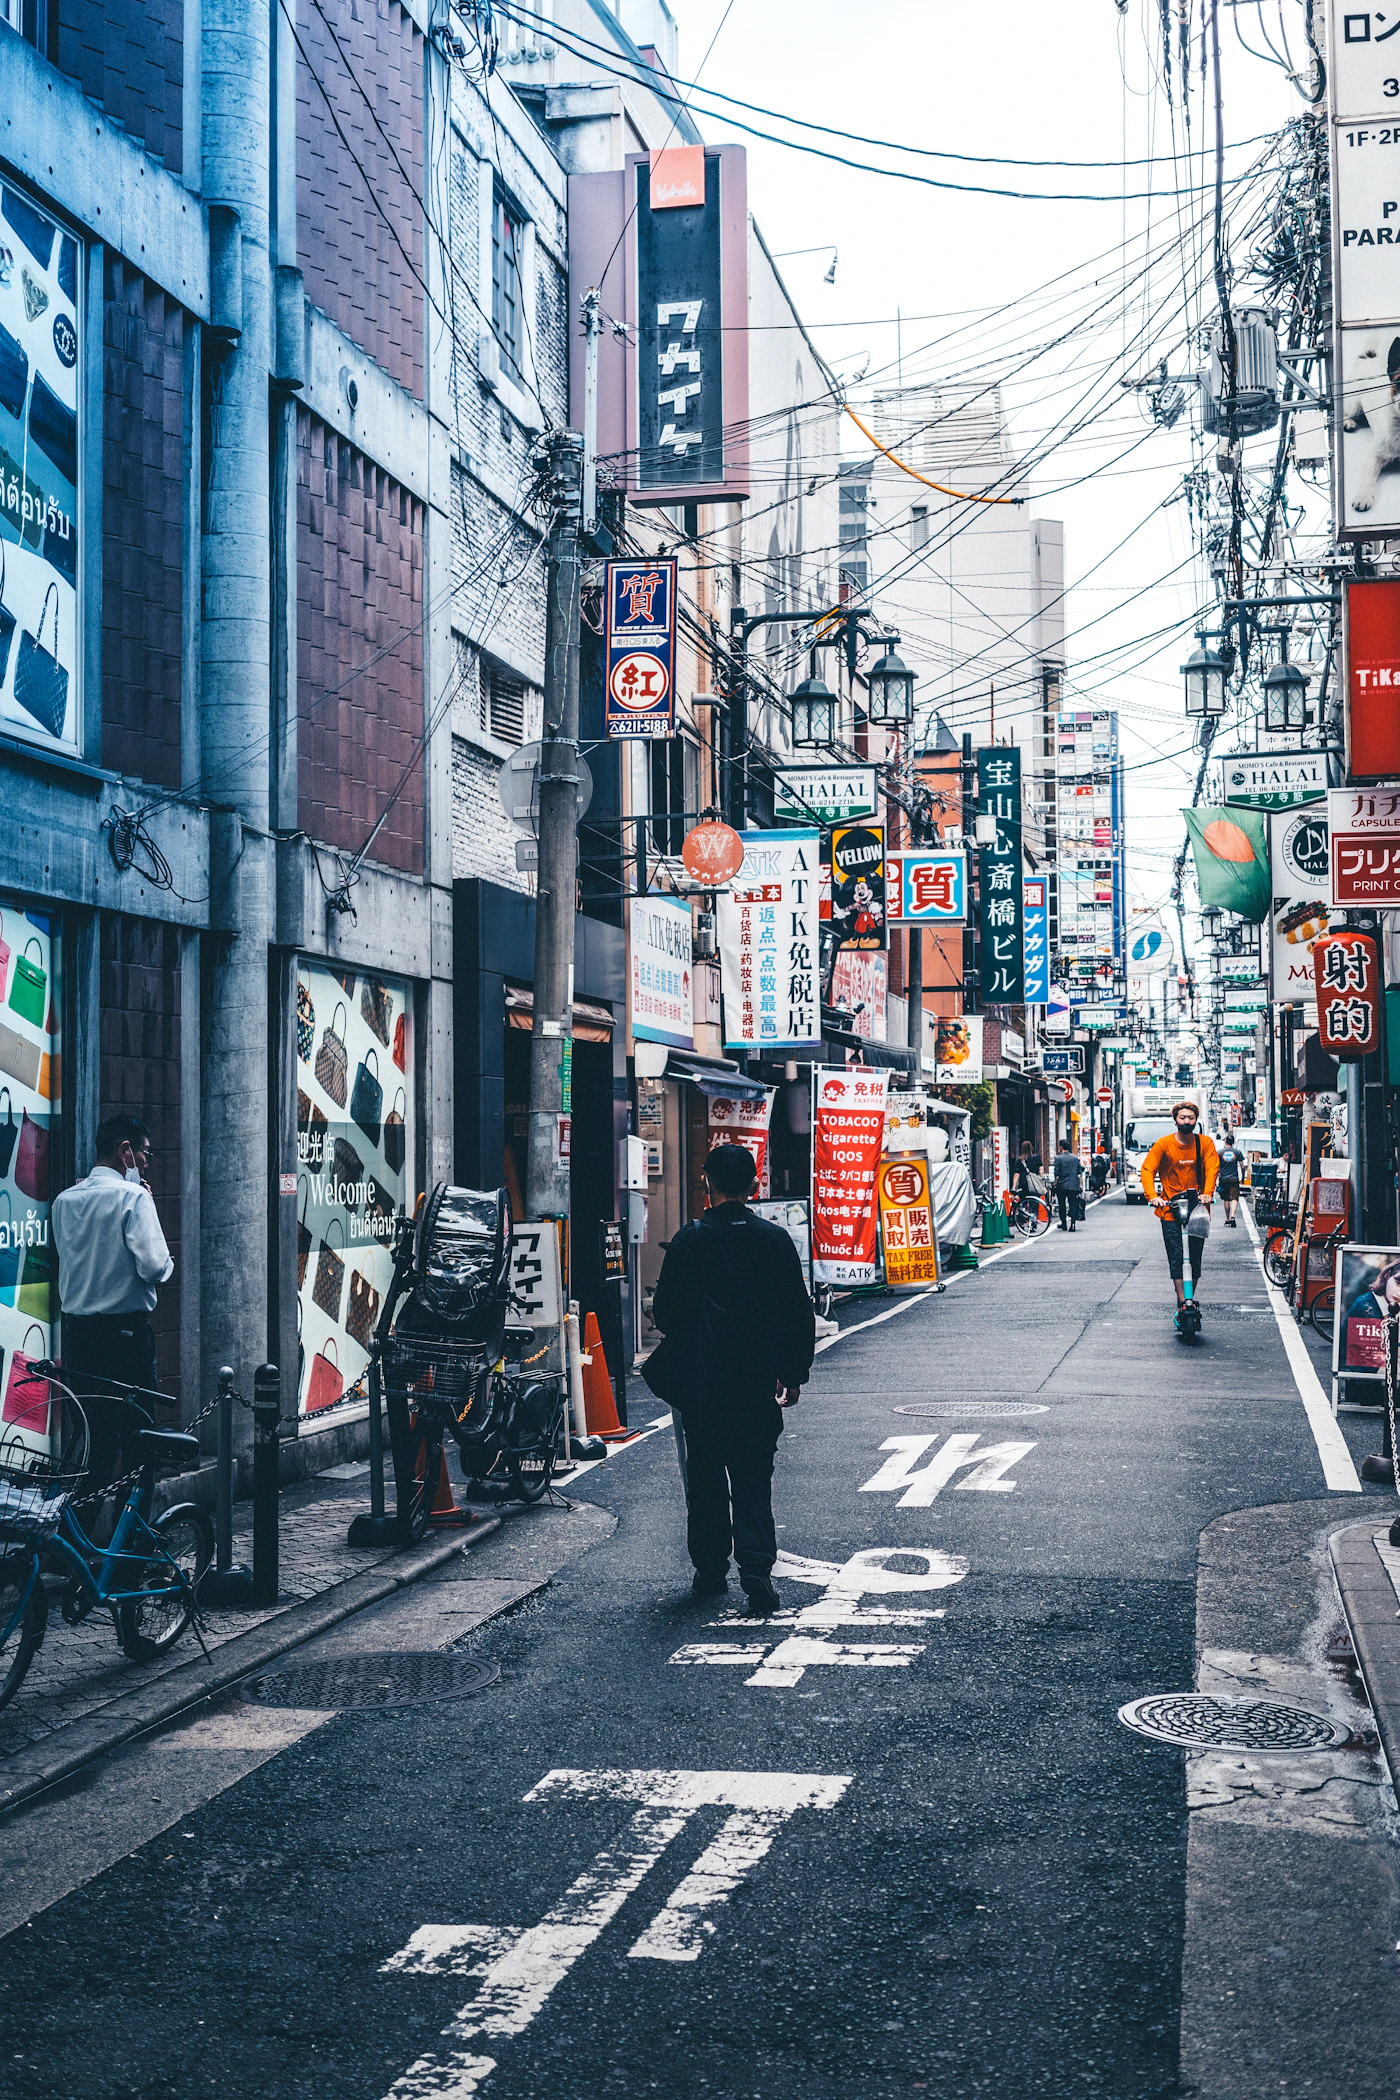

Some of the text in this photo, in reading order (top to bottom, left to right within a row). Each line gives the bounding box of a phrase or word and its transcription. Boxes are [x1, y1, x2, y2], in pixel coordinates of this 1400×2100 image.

[657, 300, 703, 456] ワカイケ
[619, 572, 663, 624] 質
[620, 662, 659, 701] 紅
[1284, 759, 1317, 767] Restaurant
[1252, 767, 1323, 785] HALAL
[800, 782, 869, 798] HALAL
[1249, 791, 1304, 805] 三ツ寺筋
[835, 844, 883, 867] YELLOW
[911, 864, 956, 911] 質
[1353, 880, 1391, 891] PRINT
[647, 912, 690, 964] ATK免税店
[787, 846, 814, 1038] ATK免税店
[1323, 941, 1371, 1044] 射的
[854, 1081, 883, 1097] 免税
[738, 1114, 766, 1123] TAXFREE
[822, 1114, 879, 1128] TOBACOO
[889, 1116, 920, 1128] 免税
[822, 1133, 877, 1145] cigarette
[832, 1150, 864, 1163] IQOS
[819, 1169, 837, 1180] たばこ
[839, 1170, 861, 1181] タバコ
[309, 1173, 376, 1207] Welcome
[887, 1168, 918, 1202] 質
[832, 1224, 854, 1237] 담배
[886, 1211, 906, 1247] 買取
[908, 1209, 931, 1246] 販売
[887, 1249, 933, 1263] TAX FREE
[848, 1268, 872, 1279] ATK
[887, 1262, 935, 1282] 無料査定
[1356, 1324, 1383, 1337] Tik
